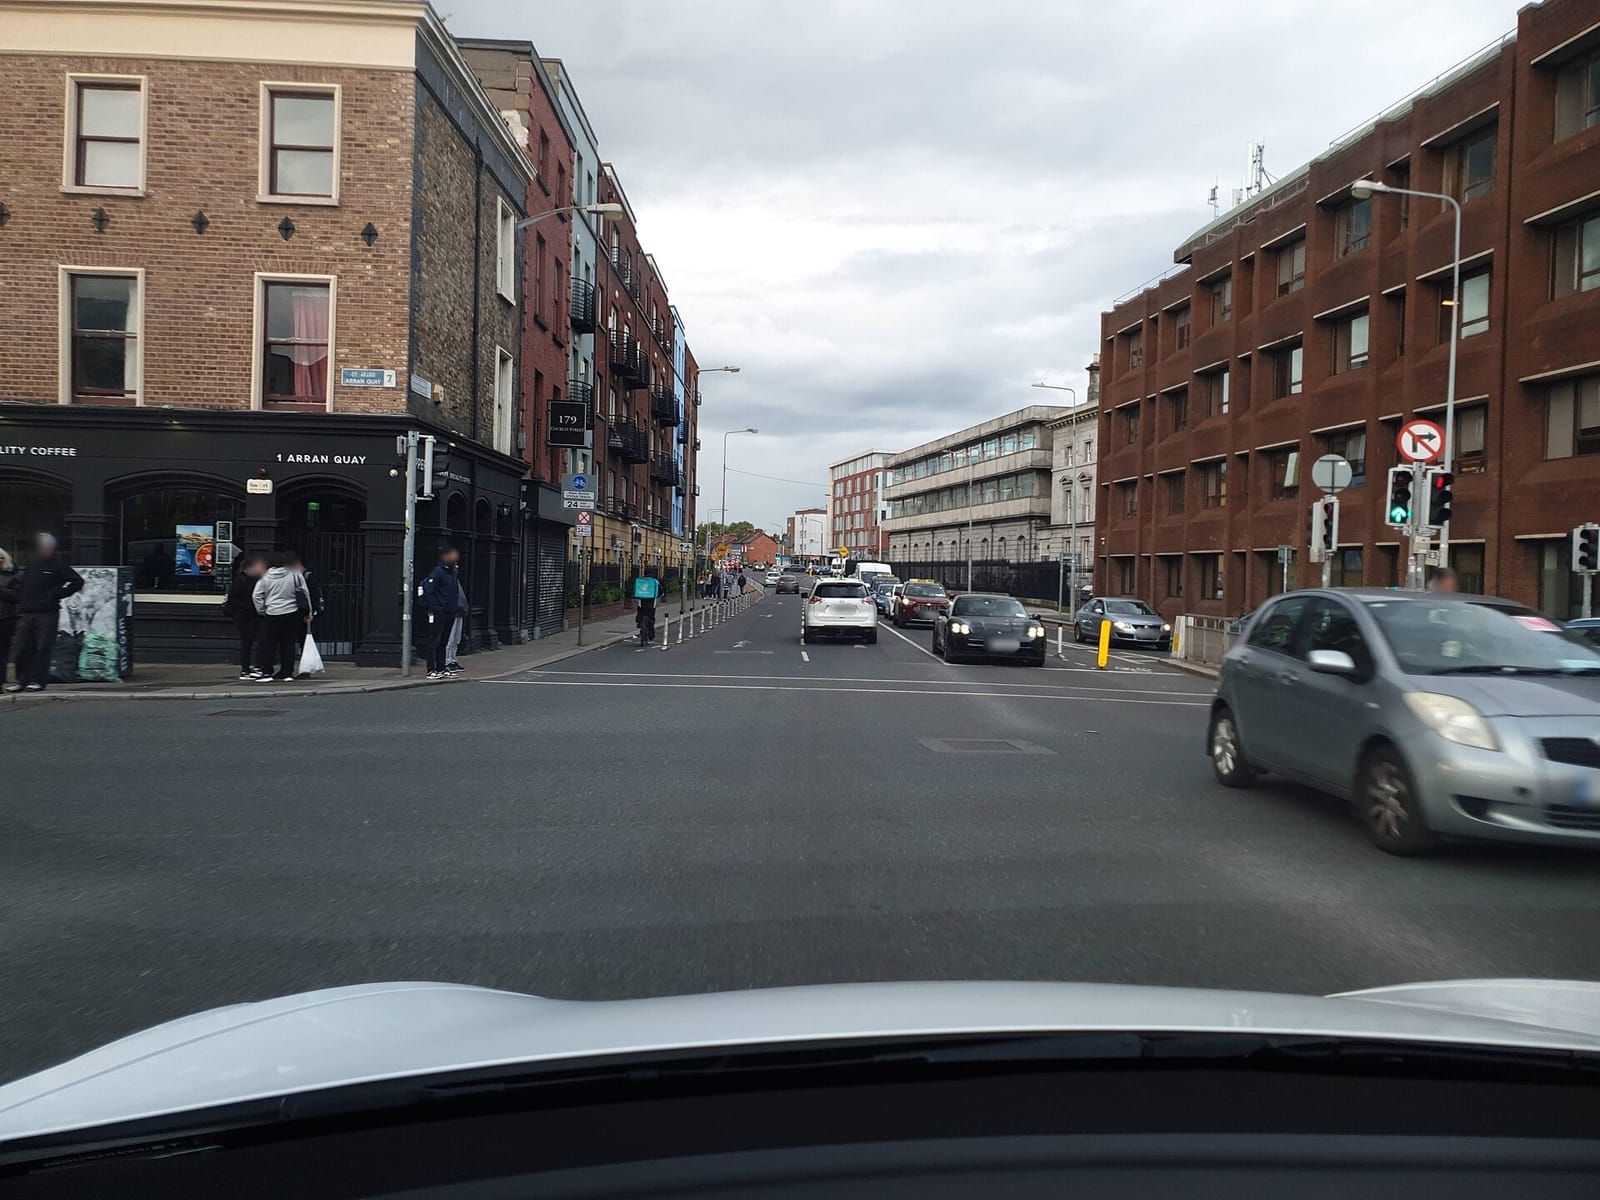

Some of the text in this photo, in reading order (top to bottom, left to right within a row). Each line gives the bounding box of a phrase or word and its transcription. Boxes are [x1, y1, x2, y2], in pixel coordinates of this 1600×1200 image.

[386, 374, 393, 383] 7
[559, 415, 577, 424] 179
[30, 446, 77, 457] COFFEE
[276, 453, 367, 464] 1 ARRAN QUAY
